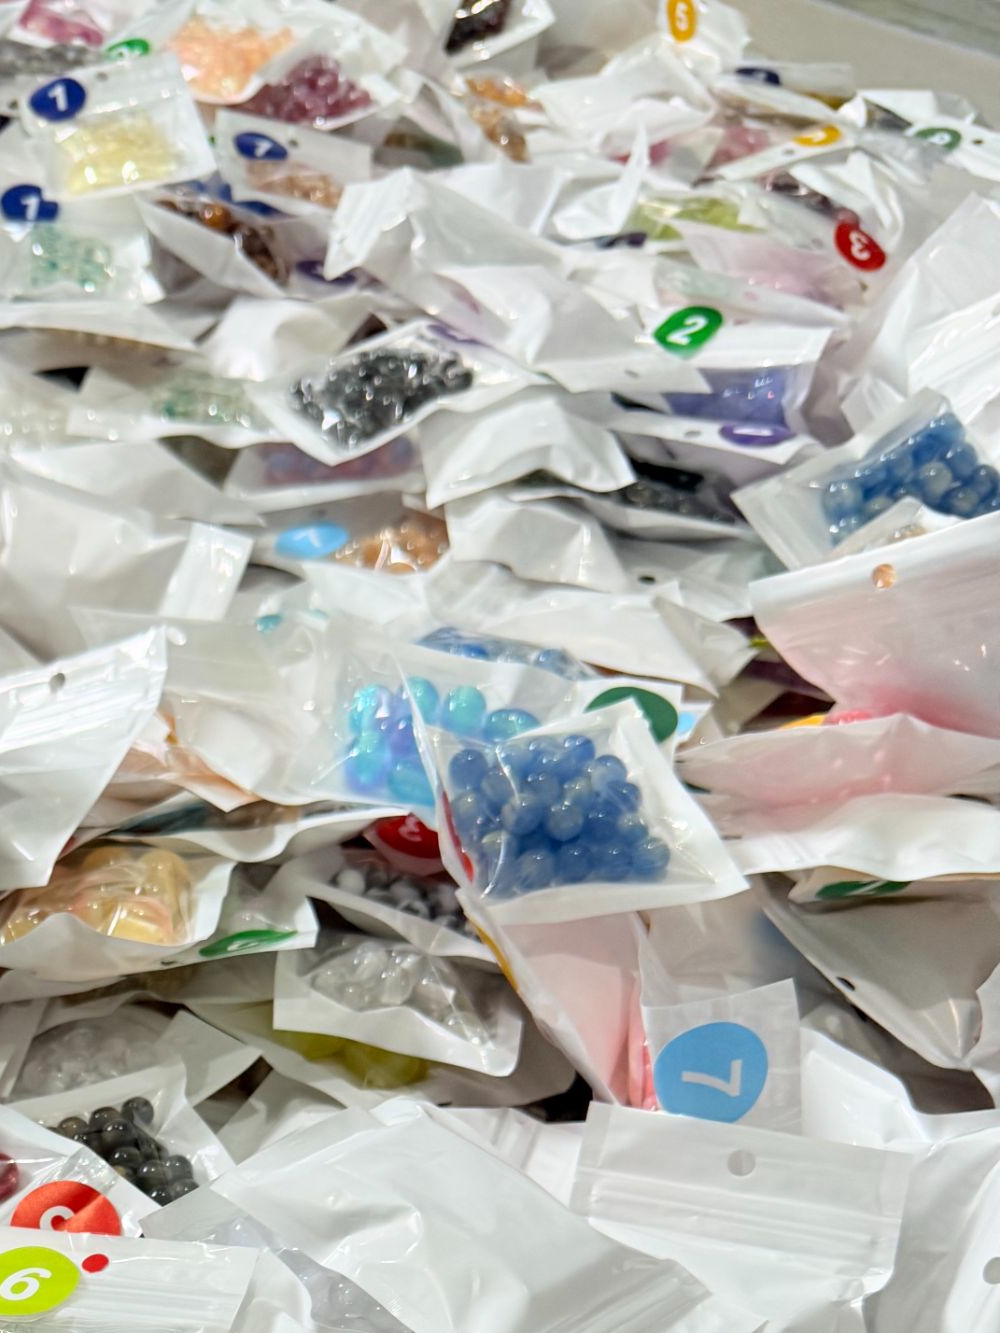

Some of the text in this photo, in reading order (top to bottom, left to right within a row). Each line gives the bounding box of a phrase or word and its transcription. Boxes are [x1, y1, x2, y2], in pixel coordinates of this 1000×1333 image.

[48, 83, 68, 113] 1
[21, 195, 39, 222] 1
[666, 315, 709, 346] 2
[681, 1059, 742, 1096] 7
